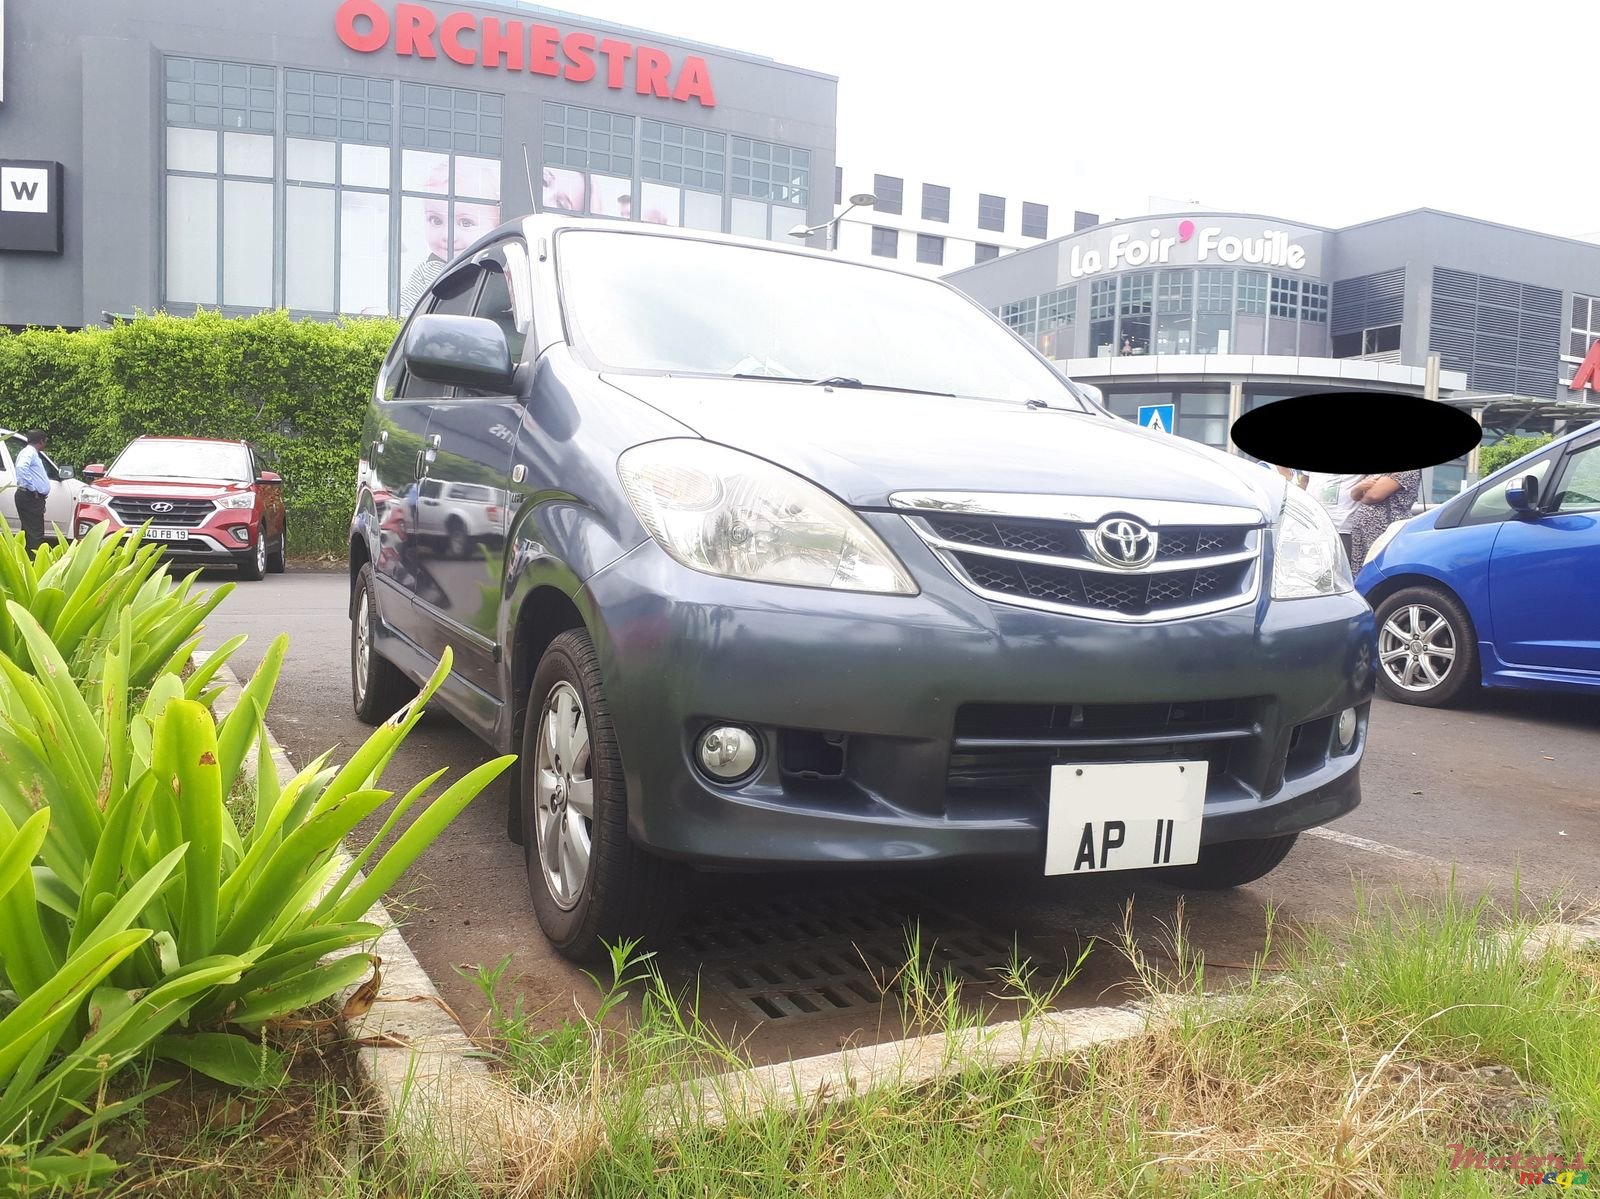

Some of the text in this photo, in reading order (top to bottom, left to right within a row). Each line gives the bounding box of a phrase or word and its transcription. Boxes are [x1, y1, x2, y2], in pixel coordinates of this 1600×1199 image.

[335, 0, 716, 107] ORCHESTRA
[10, 181, 39, 201] W
[1197, 227, 1306, 270] Fouille
[176, 531, 186, 539] 19
[1073, 819, 1174, 871] AP 11
